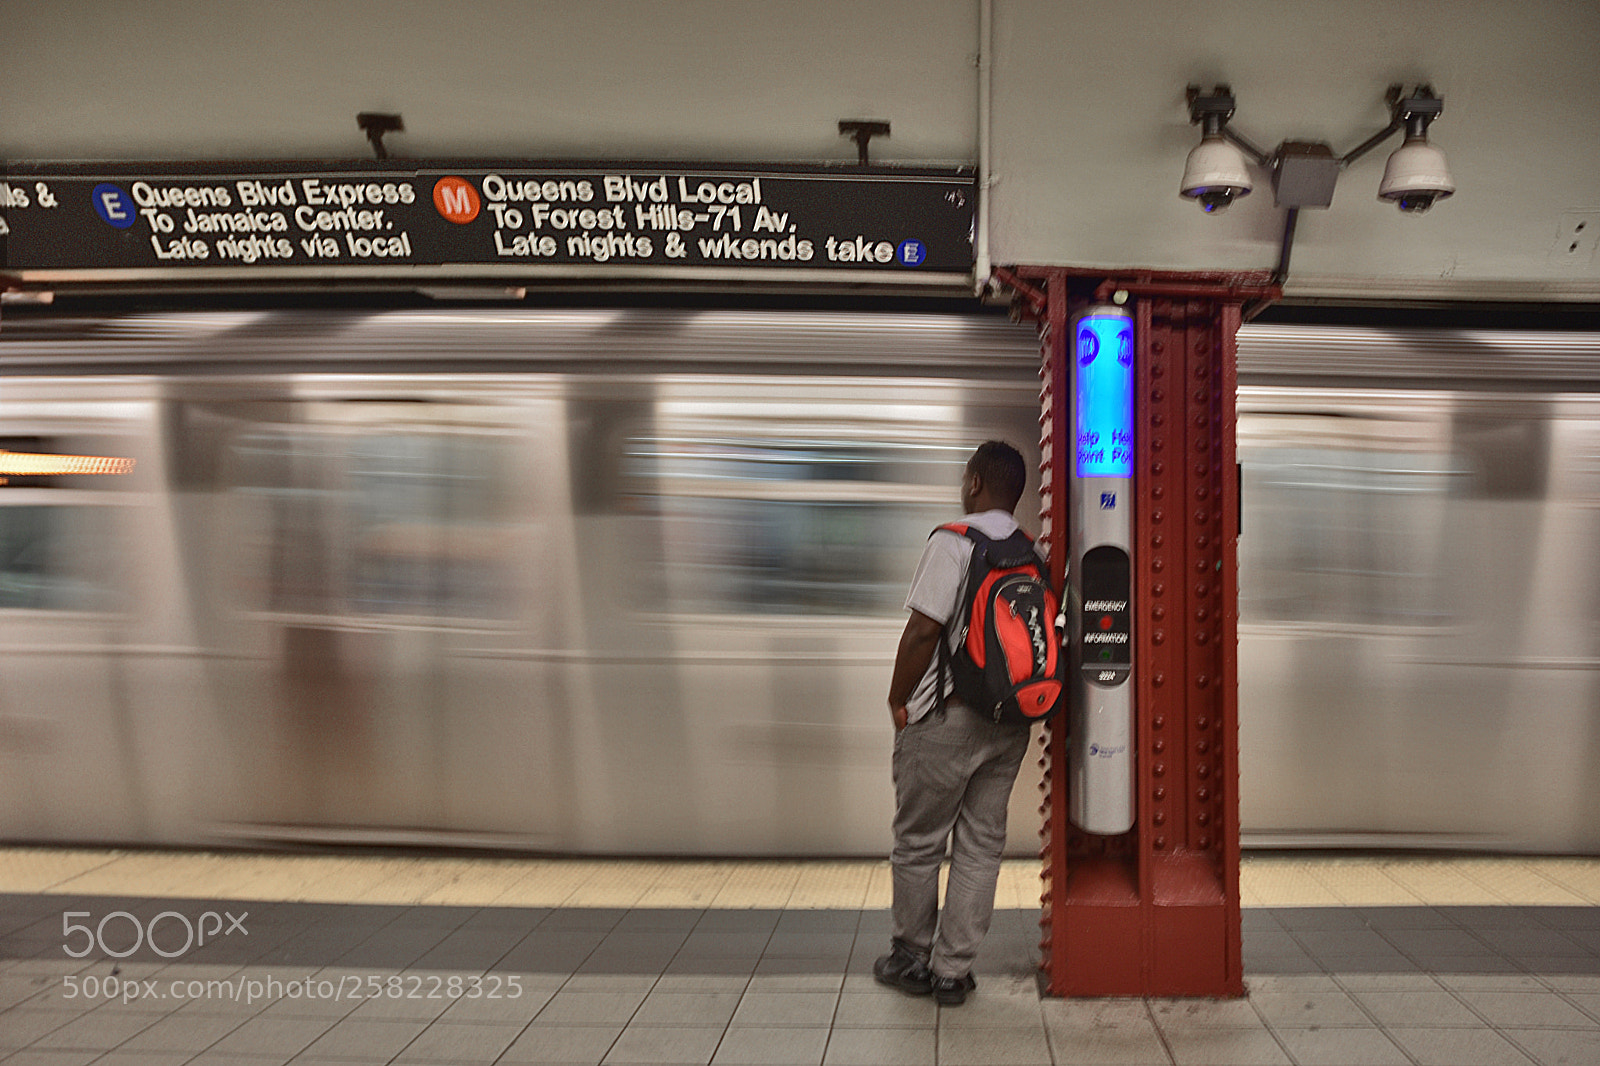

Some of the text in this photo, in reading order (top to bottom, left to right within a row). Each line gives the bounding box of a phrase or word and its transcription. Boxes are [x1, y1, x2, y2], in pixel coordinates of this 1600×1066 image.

[132, 178, 416, 208] Queens Blvd Express
[441, 186, 471, 215] M
[482, 175, 762, 204] Queens Blvd Local
[102, 193, 126, 220] E
[140, 205, 393, 233] To Jamaica Center.
[487, 203, 523, 229] To
[531, 204, 626, 229] Forest
[634, 203, 741, 232] Hills-71
[151, 231, 412, 263] Late nights via local
[493, 230, 919, 263] Late nights & wkends take E
[1084, 600, 1128, 612] EMERGENCY
[1083, 632, 1129, 644] INFORMATION
